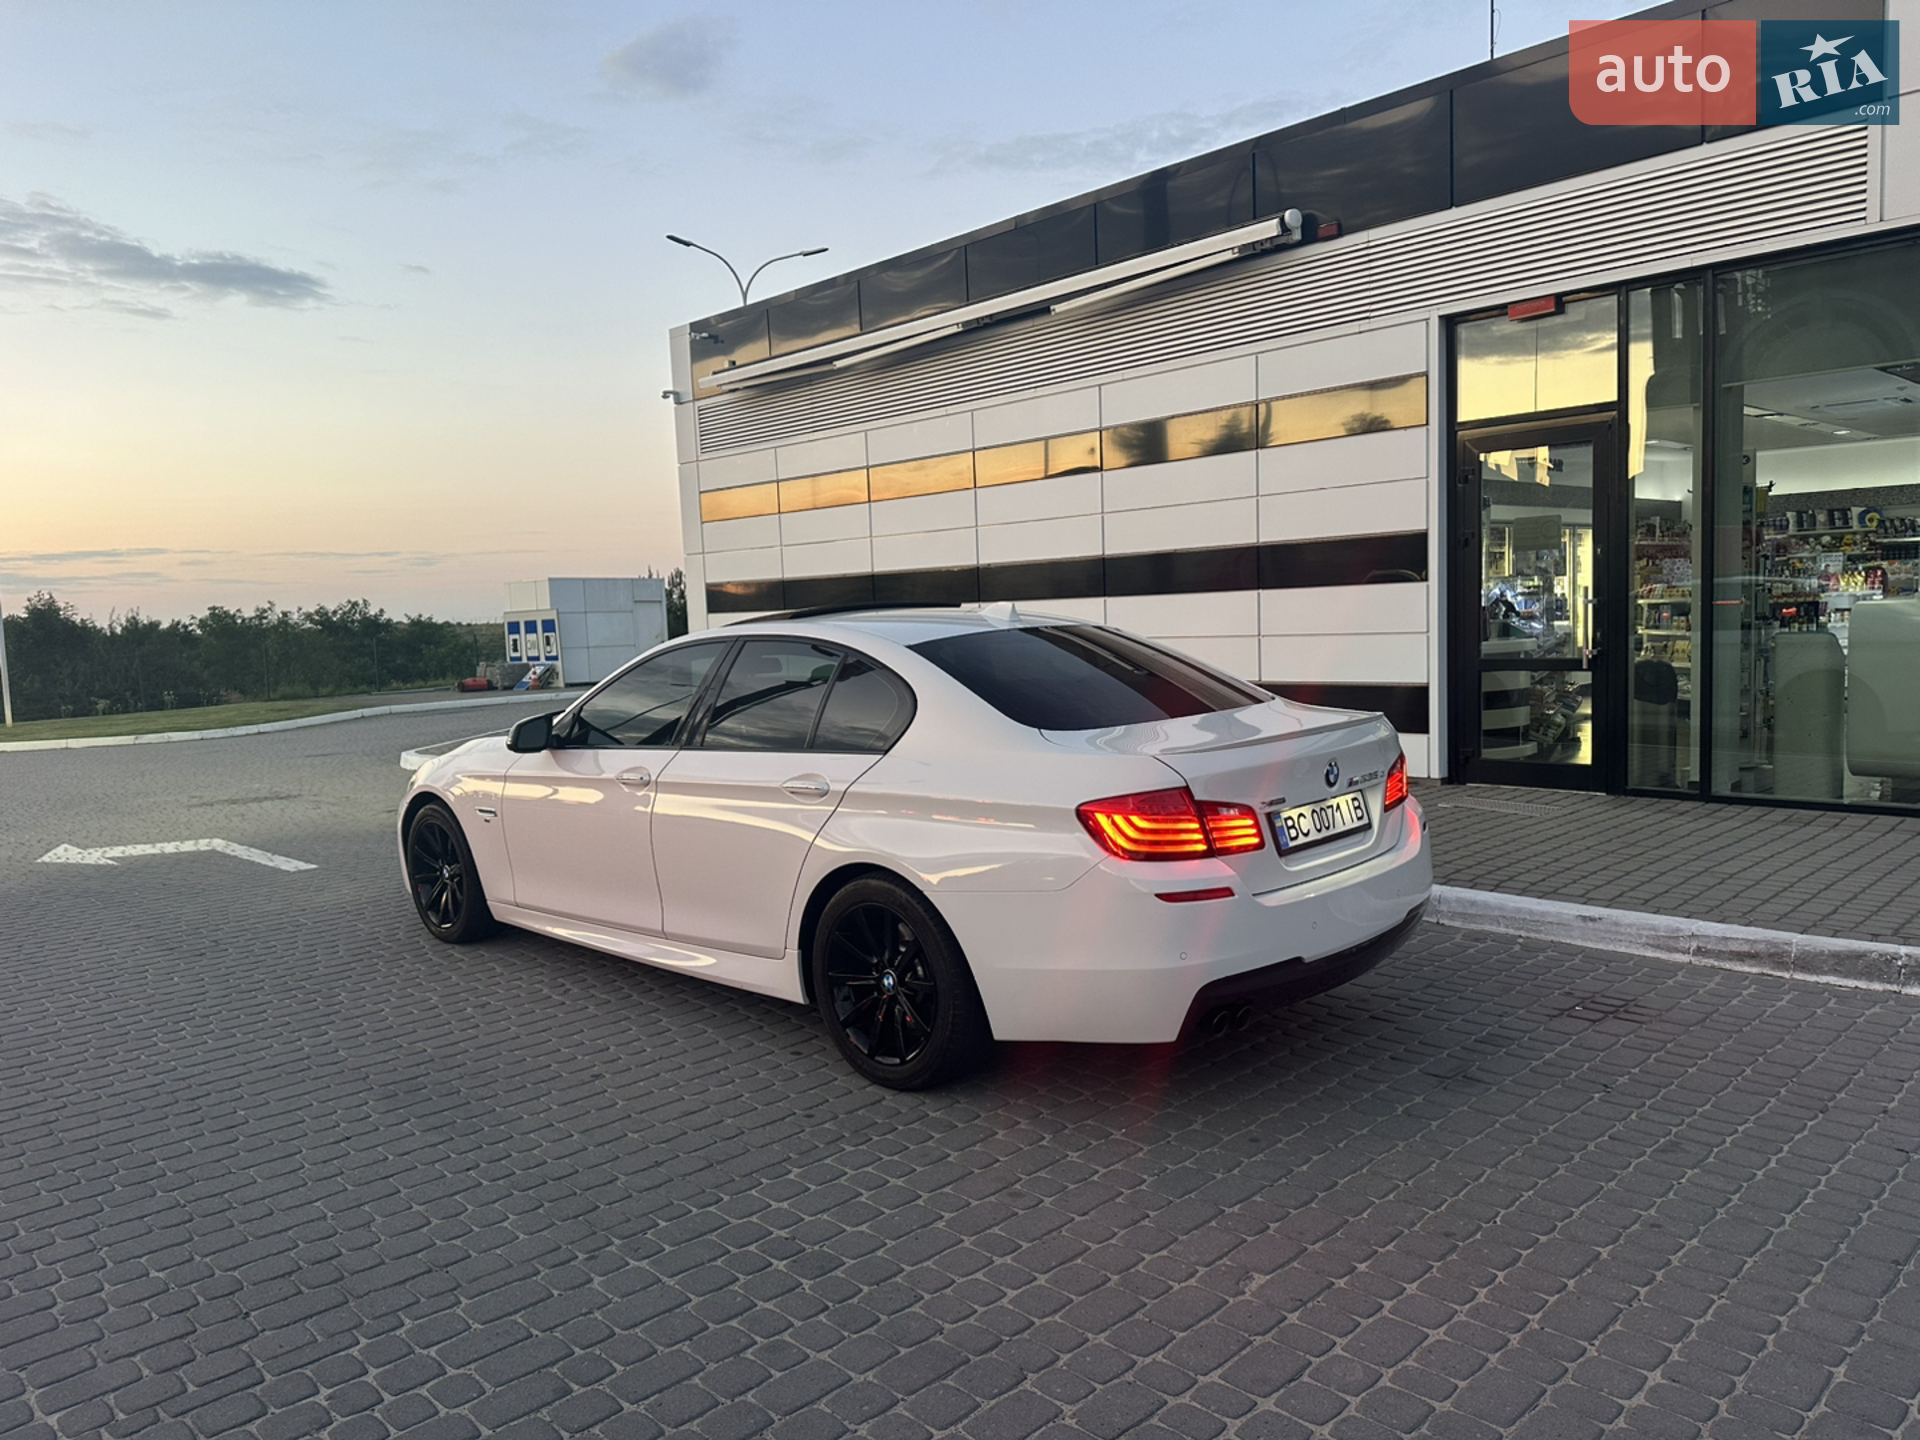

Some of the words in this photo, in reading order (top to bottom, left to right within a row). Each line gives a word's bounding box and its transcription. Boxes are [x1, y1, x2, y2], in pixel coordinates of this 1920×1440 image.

[1284, 813, 1310, 841] BC
[1312, 804, 1346, 834] 0071
[1346, 797, 1365, 823] IB
